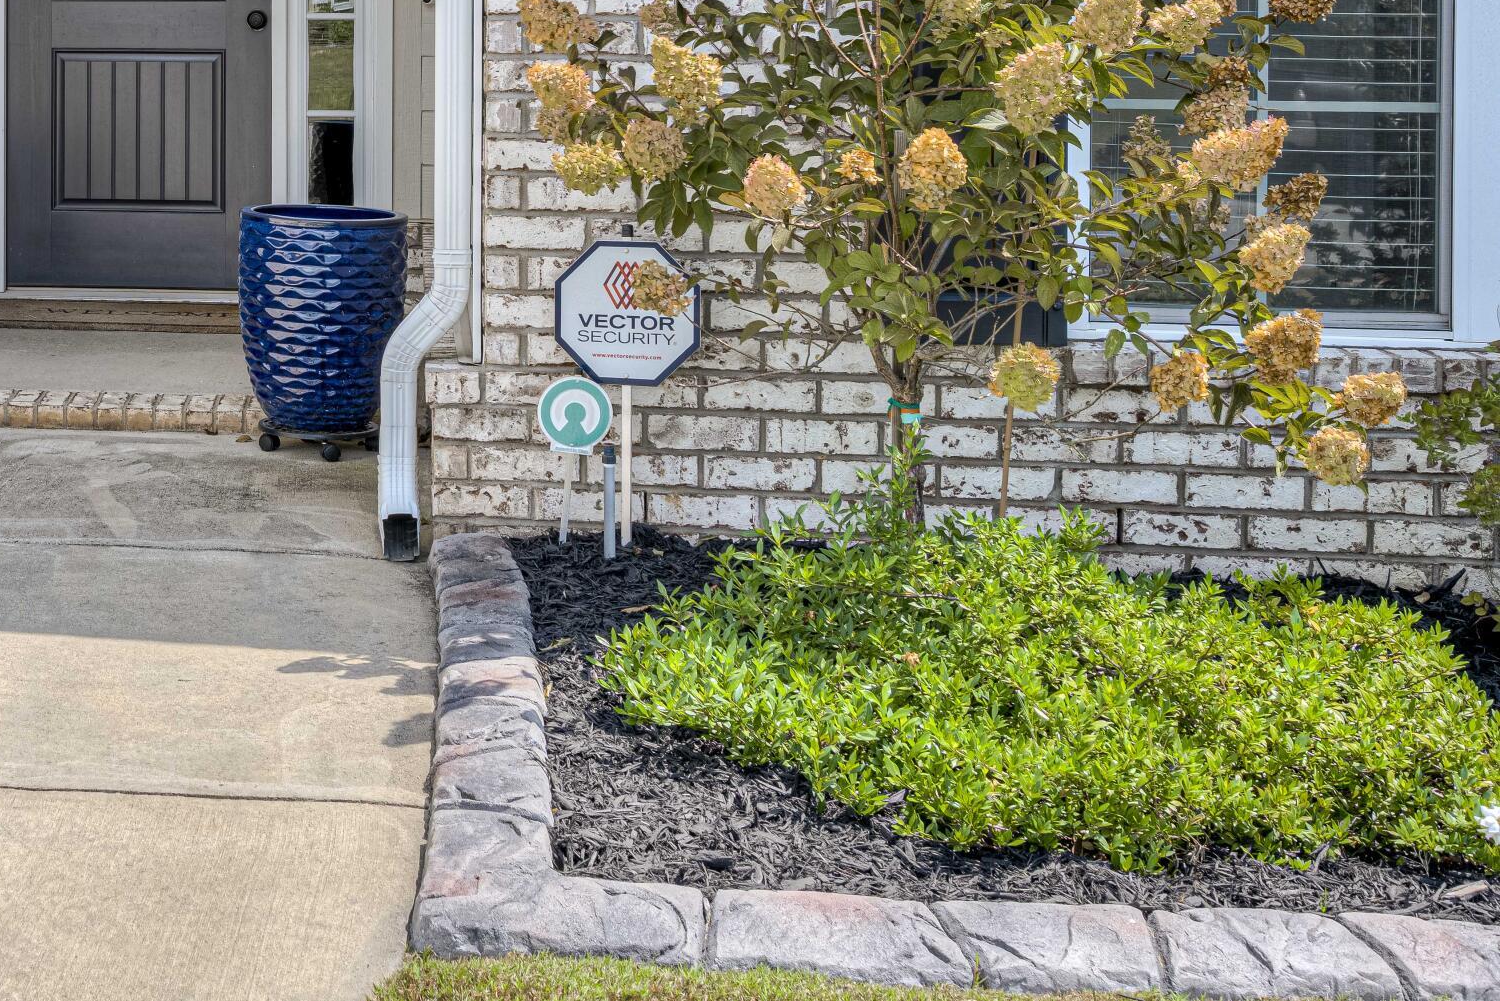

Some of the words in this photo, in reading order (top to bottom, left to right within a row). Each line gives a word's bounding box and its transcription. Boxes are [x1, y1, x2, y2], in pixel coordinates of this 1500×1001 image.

[578, 313, 675, 331] VECTOR
[577, 329, 675, 346] SECURITY
[592, 352, 662, 361] www.vectorsecurity.com
